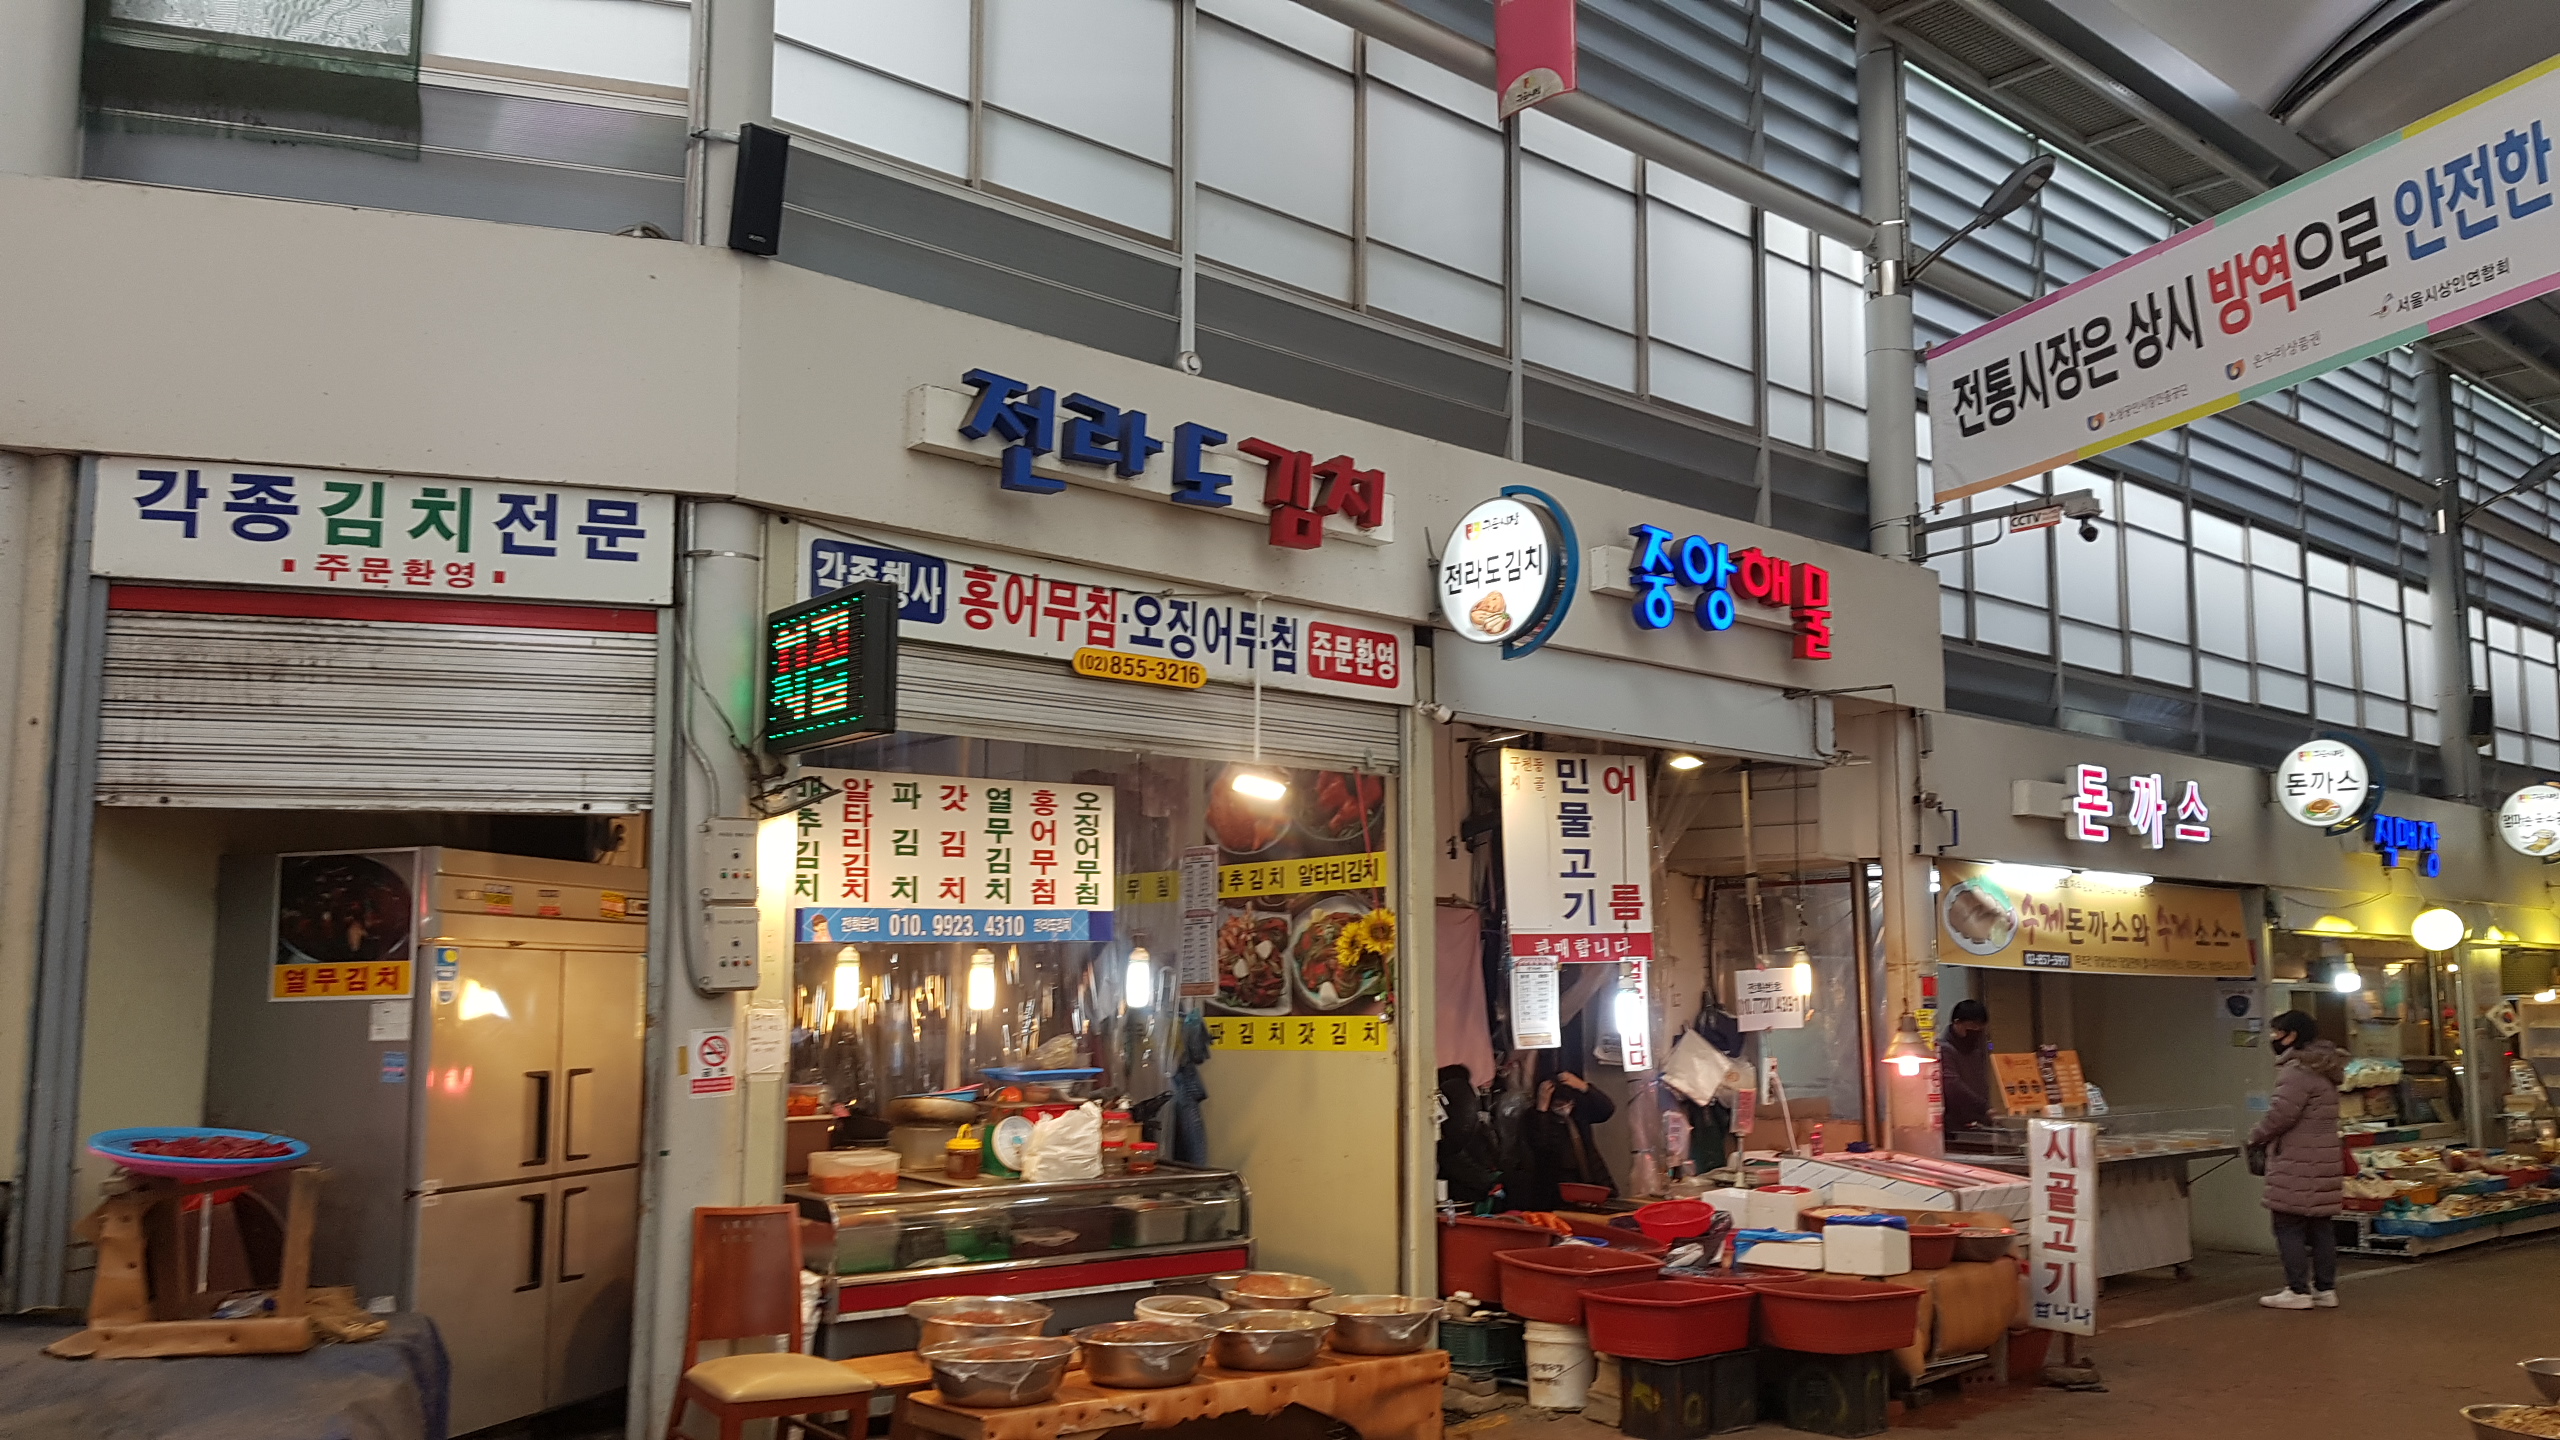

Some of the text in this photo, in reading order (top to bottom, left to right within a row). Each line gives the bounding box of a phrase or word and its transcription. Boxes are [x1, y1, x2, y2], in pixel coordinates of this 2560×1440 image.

[1951, 119, 2556, 438] 전통시장은 상시 방역으로 안전한
[2396, 256, 2512, 314] 서울시상인연합회
[958, 367, 1387, 550] 전라도김치
[134, 468, 648, 562] 각종김치전문
[2011, 512, 2042, 527] CCTV
[313, 553, 478, 588] 주문환영
[1444, 543, 1542, 596] 전라도김치
[1628, 524, 1833, 660] 중앙해물
[1079, 653, 1199, 685] (02)855-3216
[1310, 627, 1396, 681] 주문환영
[2072, 762, 2212, 851] 돈까스
[2285, 770, 2361, 797] 돈까스
[841, 777, 873, 901] 알타리김치
[891, 781, 921, 903] 파김치
[939, 784, 968, 903] 갓김치
[984, 787, 1014, 904] 열무김치
[1029, 789, 1058, 905] 홍어무침
[1073, 792, 1101, 905] 오징어무침
[1299, 857, 1379, 884] 알타리김치
[1556, 758, 1598, 926] 민물고기
[1603, 765, 1645, 921] 어름
[841, 916, 879, 932] 전화문의
[889, 914, 926, 936] 010.
[932, 914, 979, 936] 9923.
[984, 915, 1025, 936] 4310
[1534, 937, 1632, 959] 판매합니다
[2021, 893, 2150, 946] 수제돈까스와
[285, 966, 400, 994] 열무김치
[2043, 1128, 2079, 1304] 시골고기
